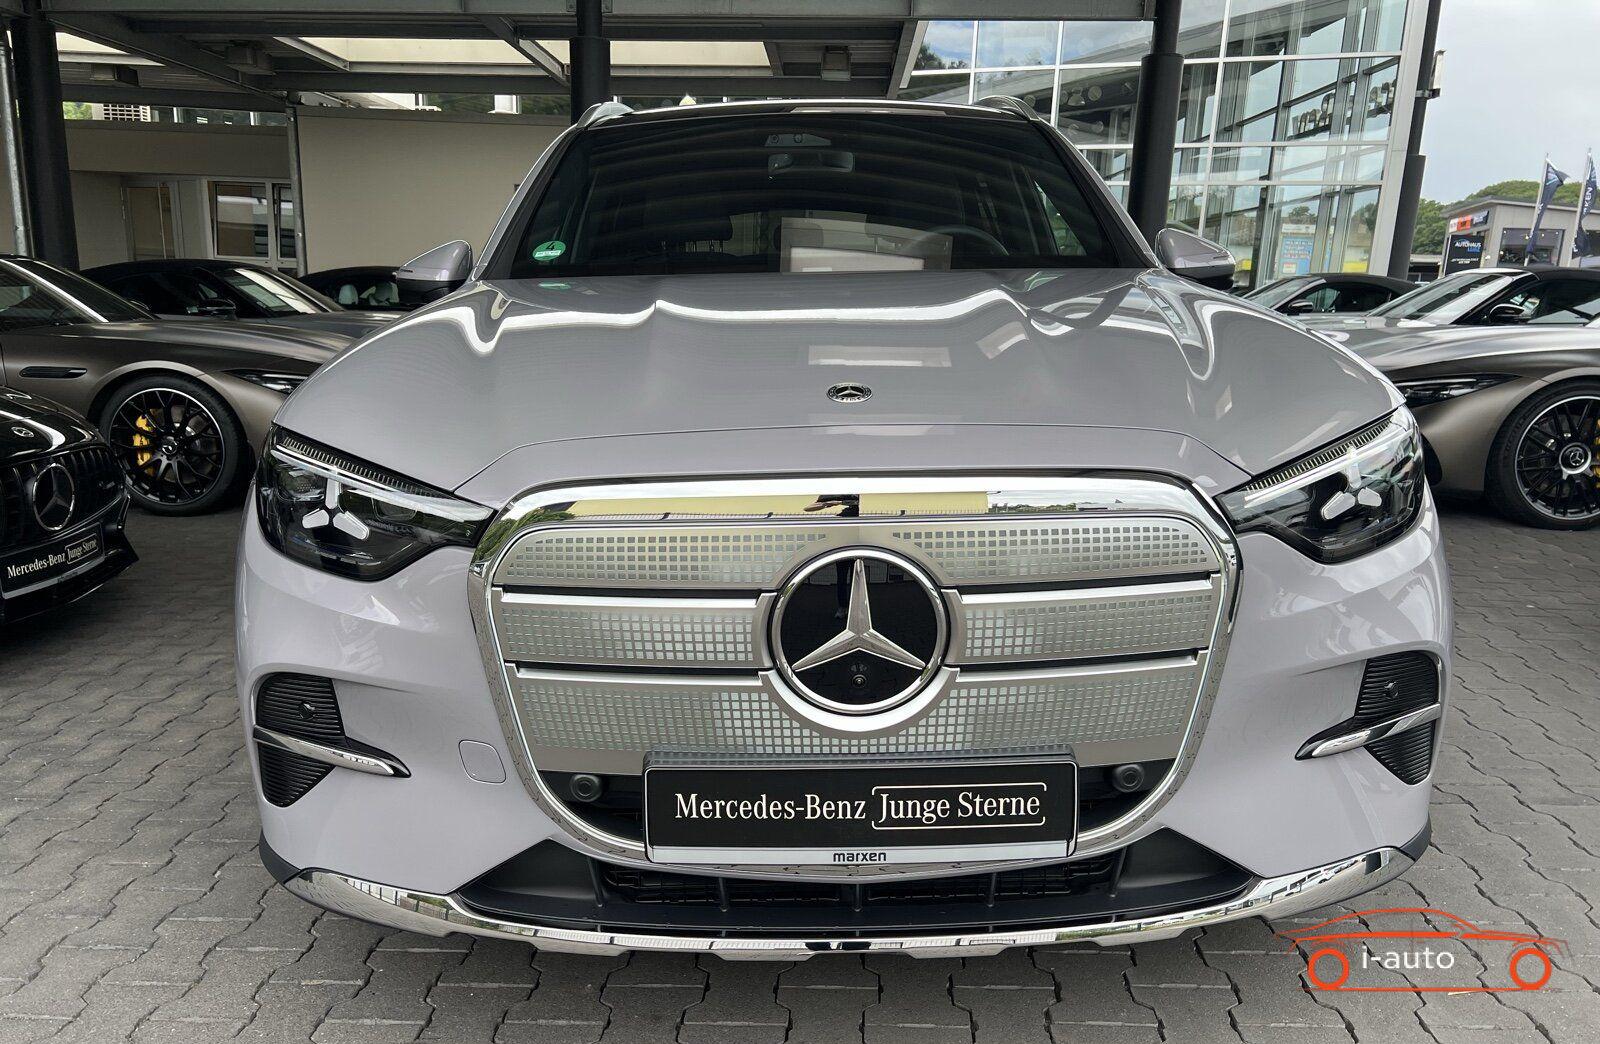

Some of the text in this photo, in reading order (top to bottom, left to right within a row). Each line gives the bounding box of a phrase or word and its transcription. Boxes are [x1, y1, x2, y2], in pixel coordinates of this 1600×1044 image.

[6, 552, 66, 579] Mercedes-Benz
[67, 547, 83, 561] Junge
[83, 539, 97, 553] Sterne
[674, 791, 1040, 825] Mercedes-Benz Junge Sterne
[832, 851, 888, 864] marxen
